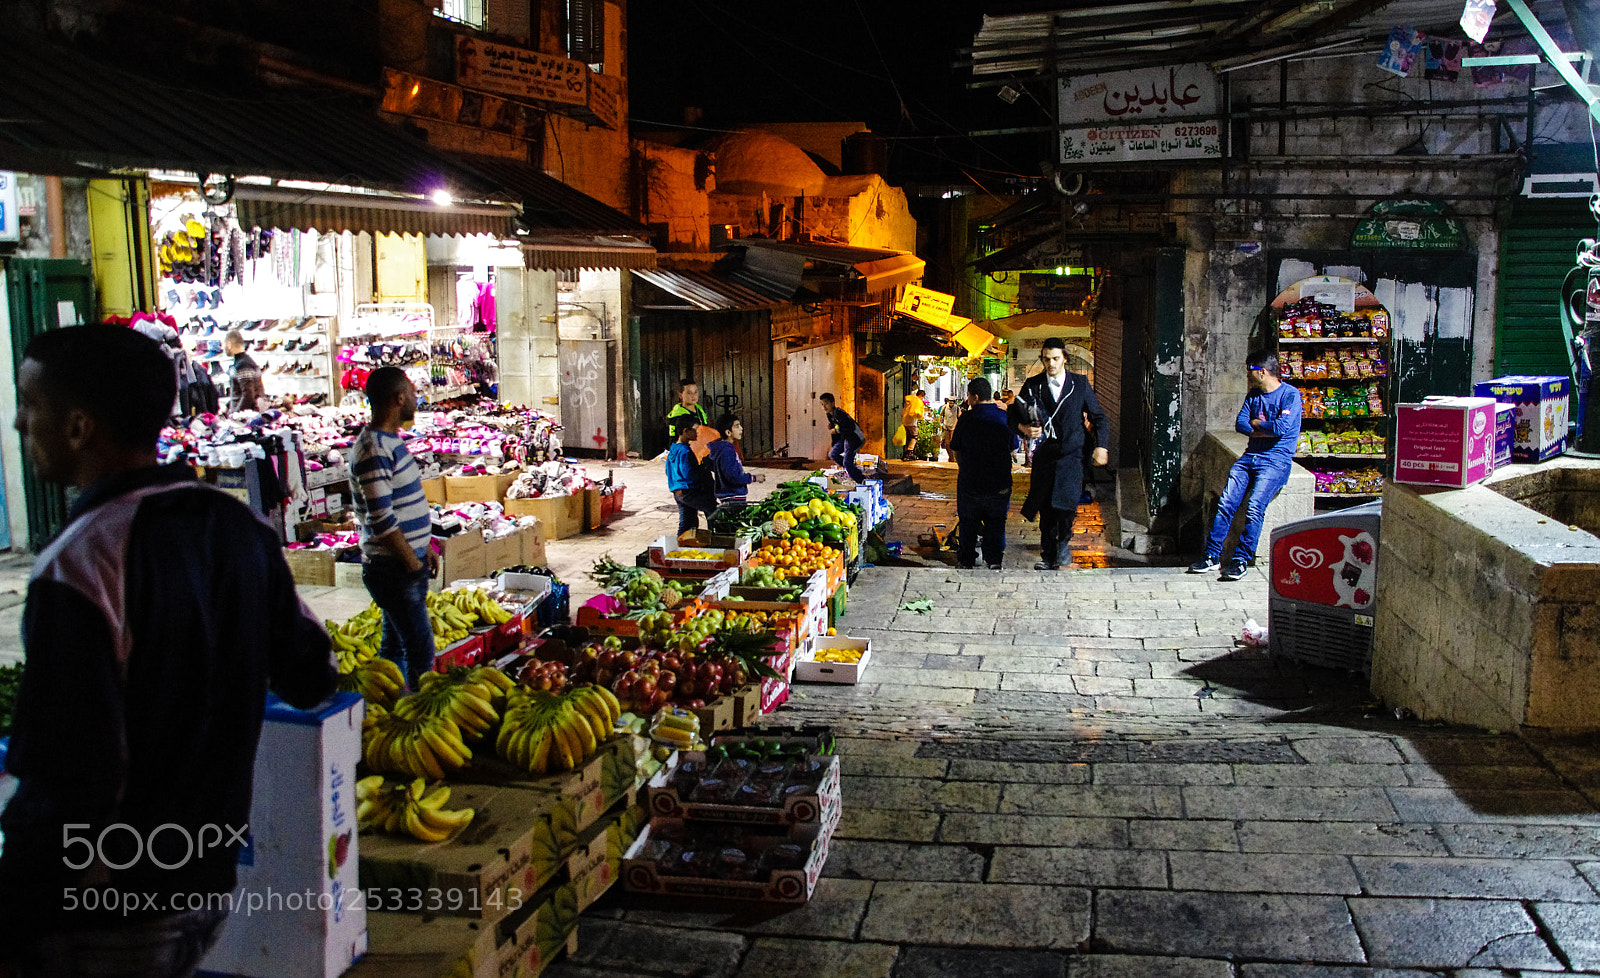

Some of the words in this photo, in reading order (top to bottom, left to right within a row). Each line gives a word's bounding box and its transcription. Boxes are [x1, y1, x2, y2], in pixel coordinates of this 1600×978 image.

[1073, 81, 1108, 102] ABDEEN
[1103, 66, 1201, 117] عابدين
[1098, 129, 1162, 141] CITIZEN
[1174, 126, 1218, 138] 6273698
[1128, 139, 1158, 151] الساعات
[1185, 137, 1203, 149] كافة
[1413, 444, 1433, 452] Original
[1412, 462, 1425, 470] pcs
